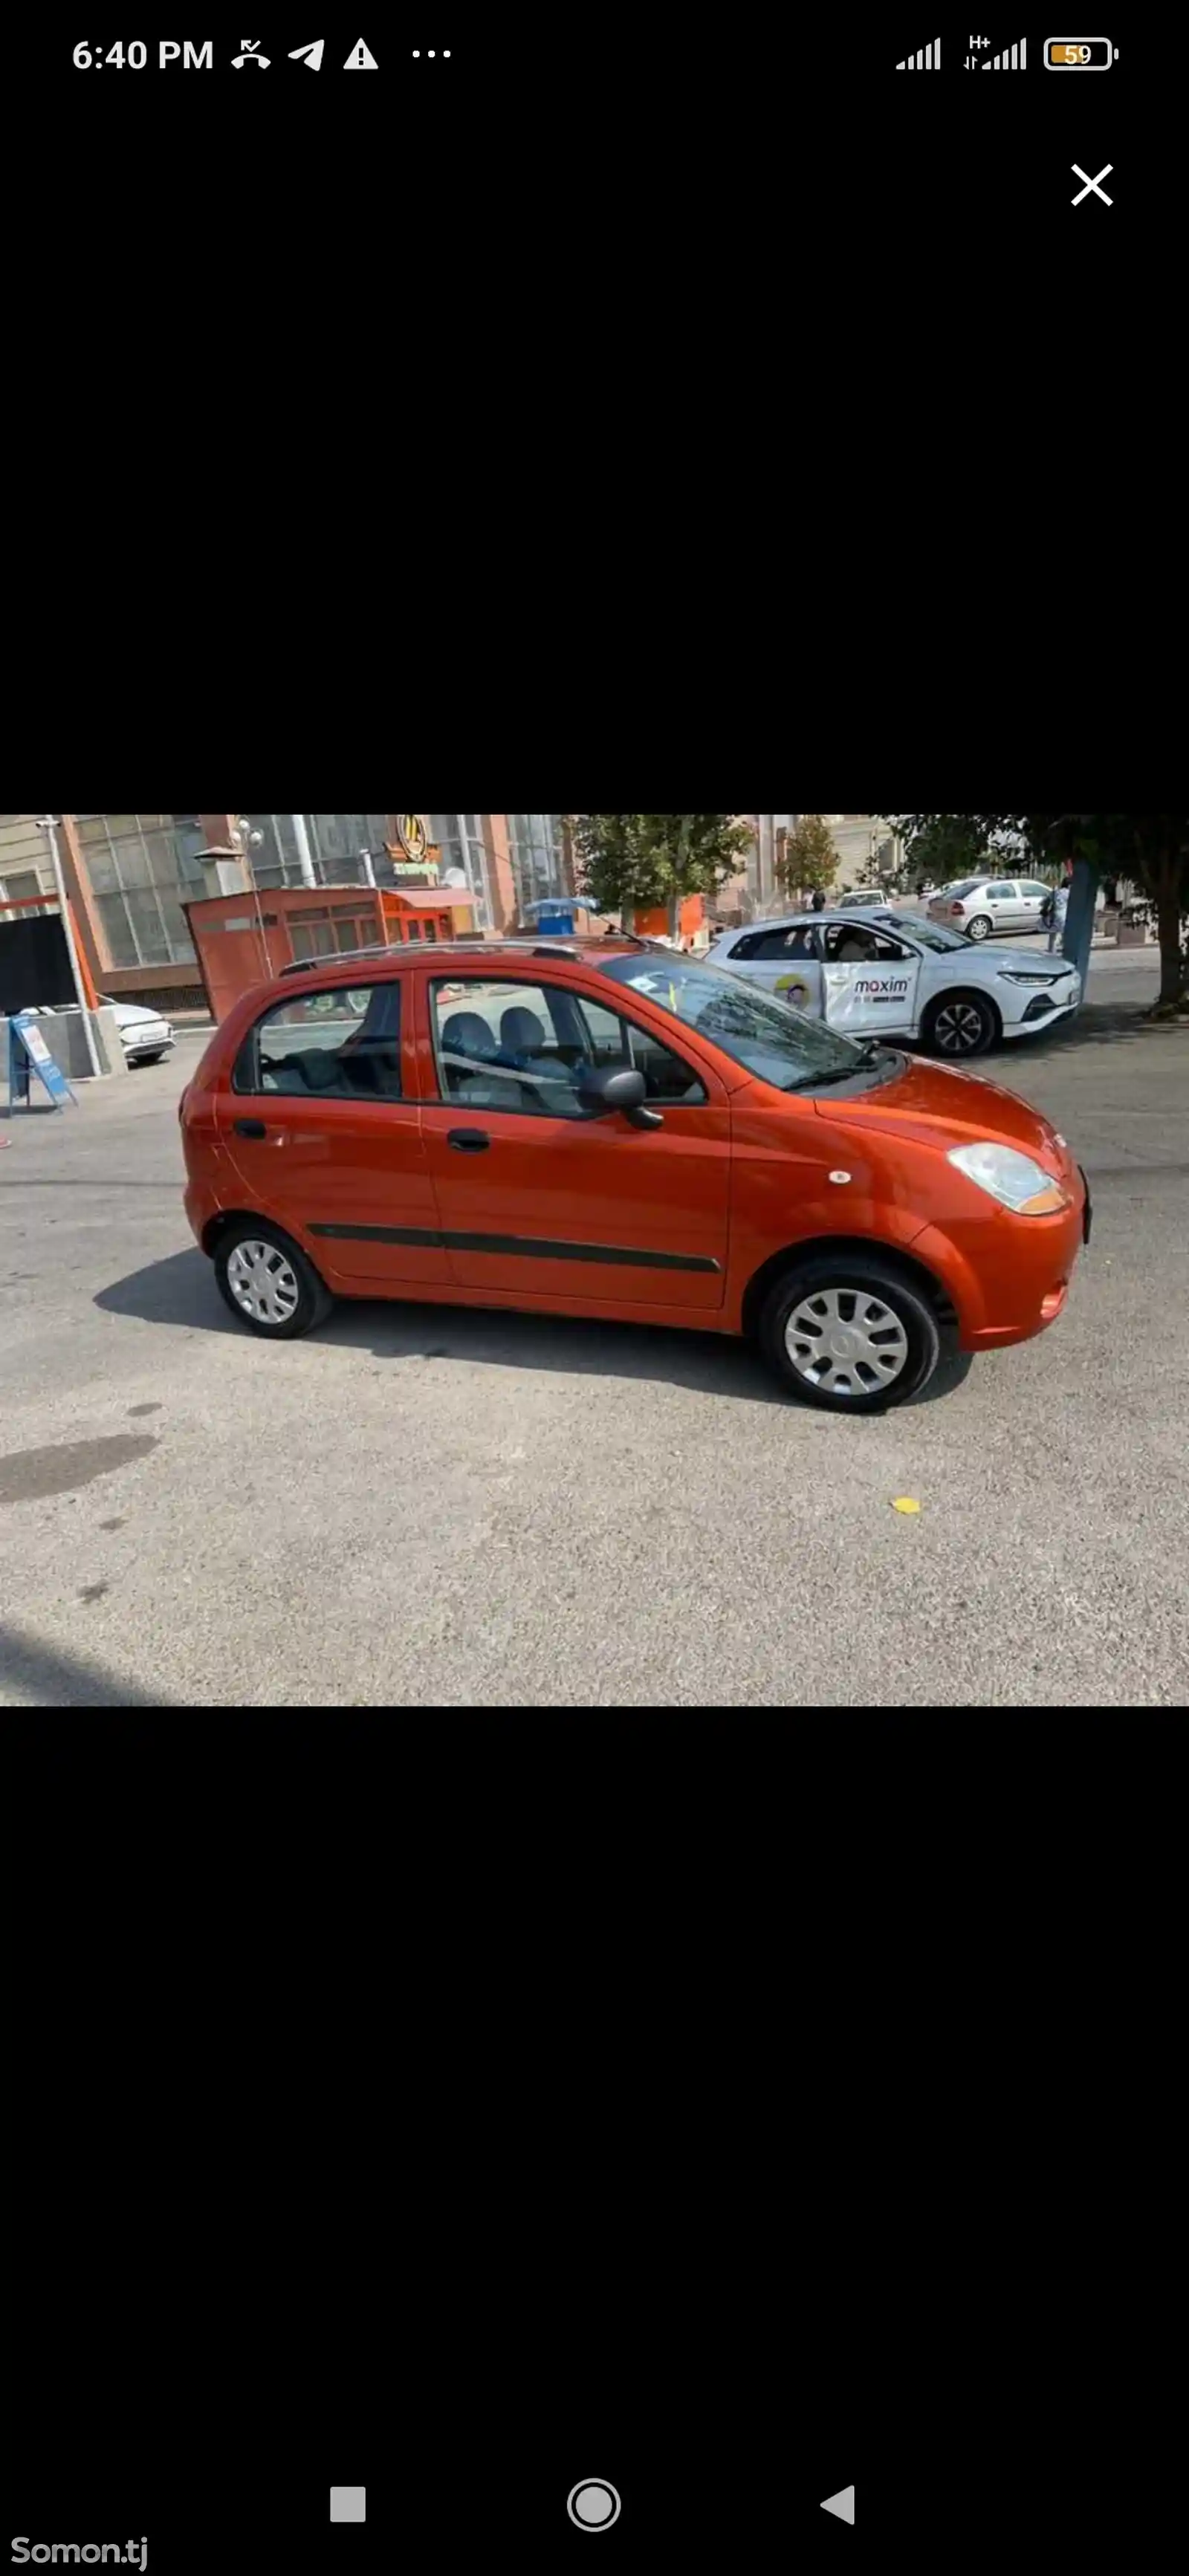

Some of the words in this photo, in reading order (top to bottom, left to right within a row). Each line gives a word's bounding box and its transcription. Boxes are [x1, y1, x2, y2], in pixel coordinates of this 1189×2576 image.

[969, 35, 991, 50] H+
[72, 40, 147, 70] 6:40
[159, 41, 213, 69] PM
[1064, 45, 1092, 65] 59
[854, 976, 907, 993] maxim
